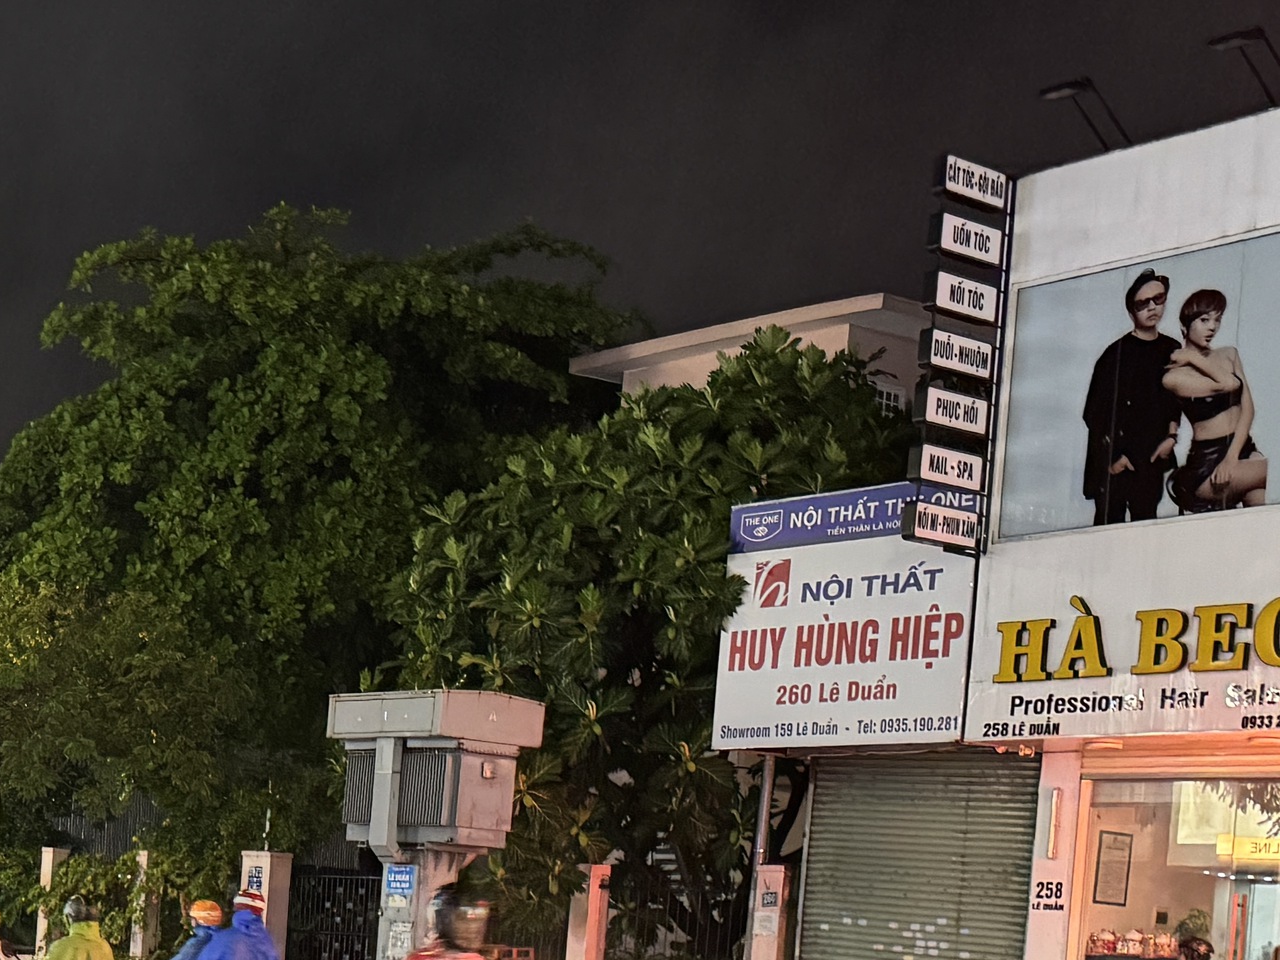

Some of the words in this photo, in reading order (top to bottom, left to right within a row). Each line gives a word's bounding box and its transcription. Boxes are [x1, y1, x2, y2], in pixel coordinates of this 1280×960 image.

[953, 222, 971, 248] UỐN
[974, 229, 990, 254] TÓC
[949, 281, 965, 306] NỐI
[967, 287, 984, 311] TÓC
[936, 398, 961, 423] PHỤC
[928, 453, 948, 476] NAIL
[956, 460, 973, 481] SPA
[745, 516, 760, 527] THE
[762, 514, 779, 525] ONE
[790, 505, 821, 530] NỘI
[827, 496, 880, 524] THẤT
[801, 573, 853, 605] NỘI
[861, 561, 943, 597] THẤT
[728, 626, 787, 672] HUY
[793, 613, 880, 668] HÙNG
[888, 603, 965, 670] HIỆP
[993, 595, 1112, 684] HÀ
[775, 683, 812, 706] 260
[818, 682, 840, 703] Lê
[847, 675, 897, 702] Duẩn
[1010, 687, 1145, 717] Professional
[1160, 687, 1209, 710] Hair
[720, 723, 770, 740] Showroom
[774, 722, 793, 738] 159
[796, 721, 808, 737] Lê
[812, 717, 838, 736] Duẩn
[857, 718, 877, 735] Tel:
[880, 715, 959, 735] 0935.190.281
[983, 722, 1009, 738] 258
[1012, 720, 1025, 737] LÊ
[1029, 717, 1060, 736] DUẨN
[1241, 714, 1273, 730] 0933
[1035, 881, 1063, 899] 258
